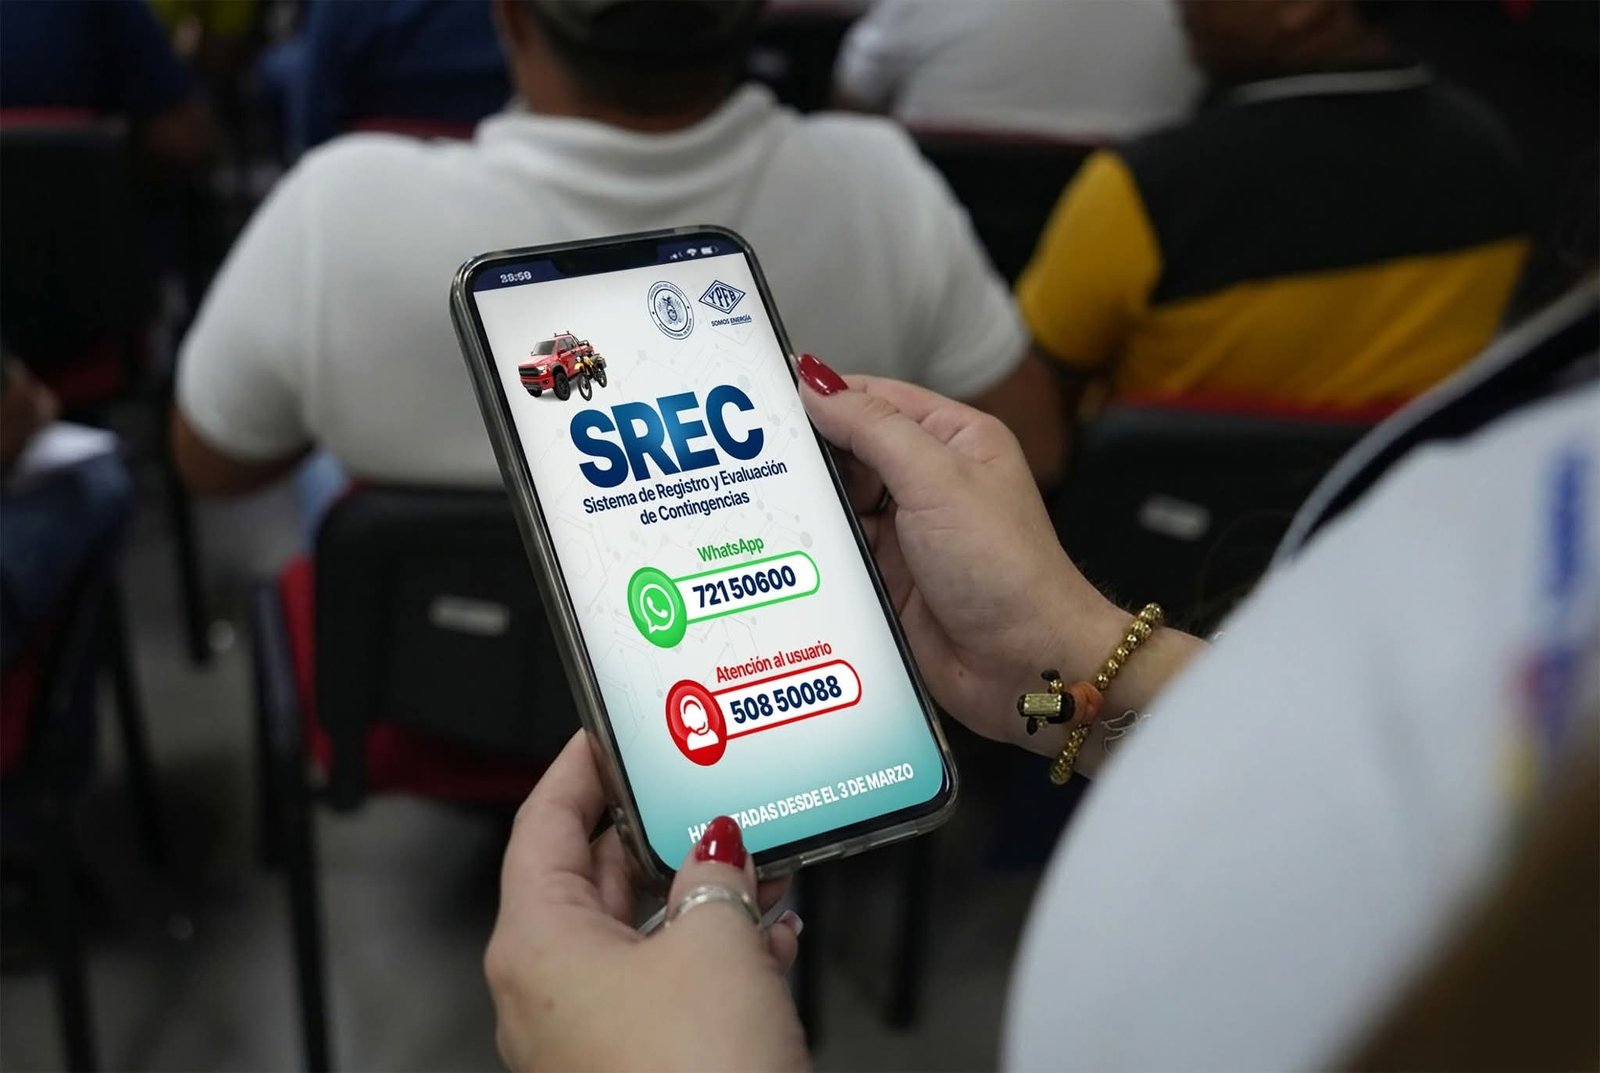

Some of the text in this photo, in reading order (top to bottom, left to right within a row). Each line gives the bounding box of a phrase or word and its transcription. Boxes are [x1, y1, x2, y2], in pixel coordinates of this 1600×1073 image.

[709, 286, 737, 308] YPFB
[711, 318, 730, 327] SOMOS
[570, 384, 764, 488] SREC
[583, 459, 788, 514] Sistema de Registro y Evaluación
[640, 490, 750, 525] de Contingencias
[697, 537, 764, 562] WhatsApp
[716, 640, 833, 683] Atención al usuario
[778, 789, 822, 817] DESDE
[820, 785, 839, 805] EL
[839, 782, 848, 798] 3
[847, 776, 869, 798] DE
[865, 763, 914, 791] MARZO
